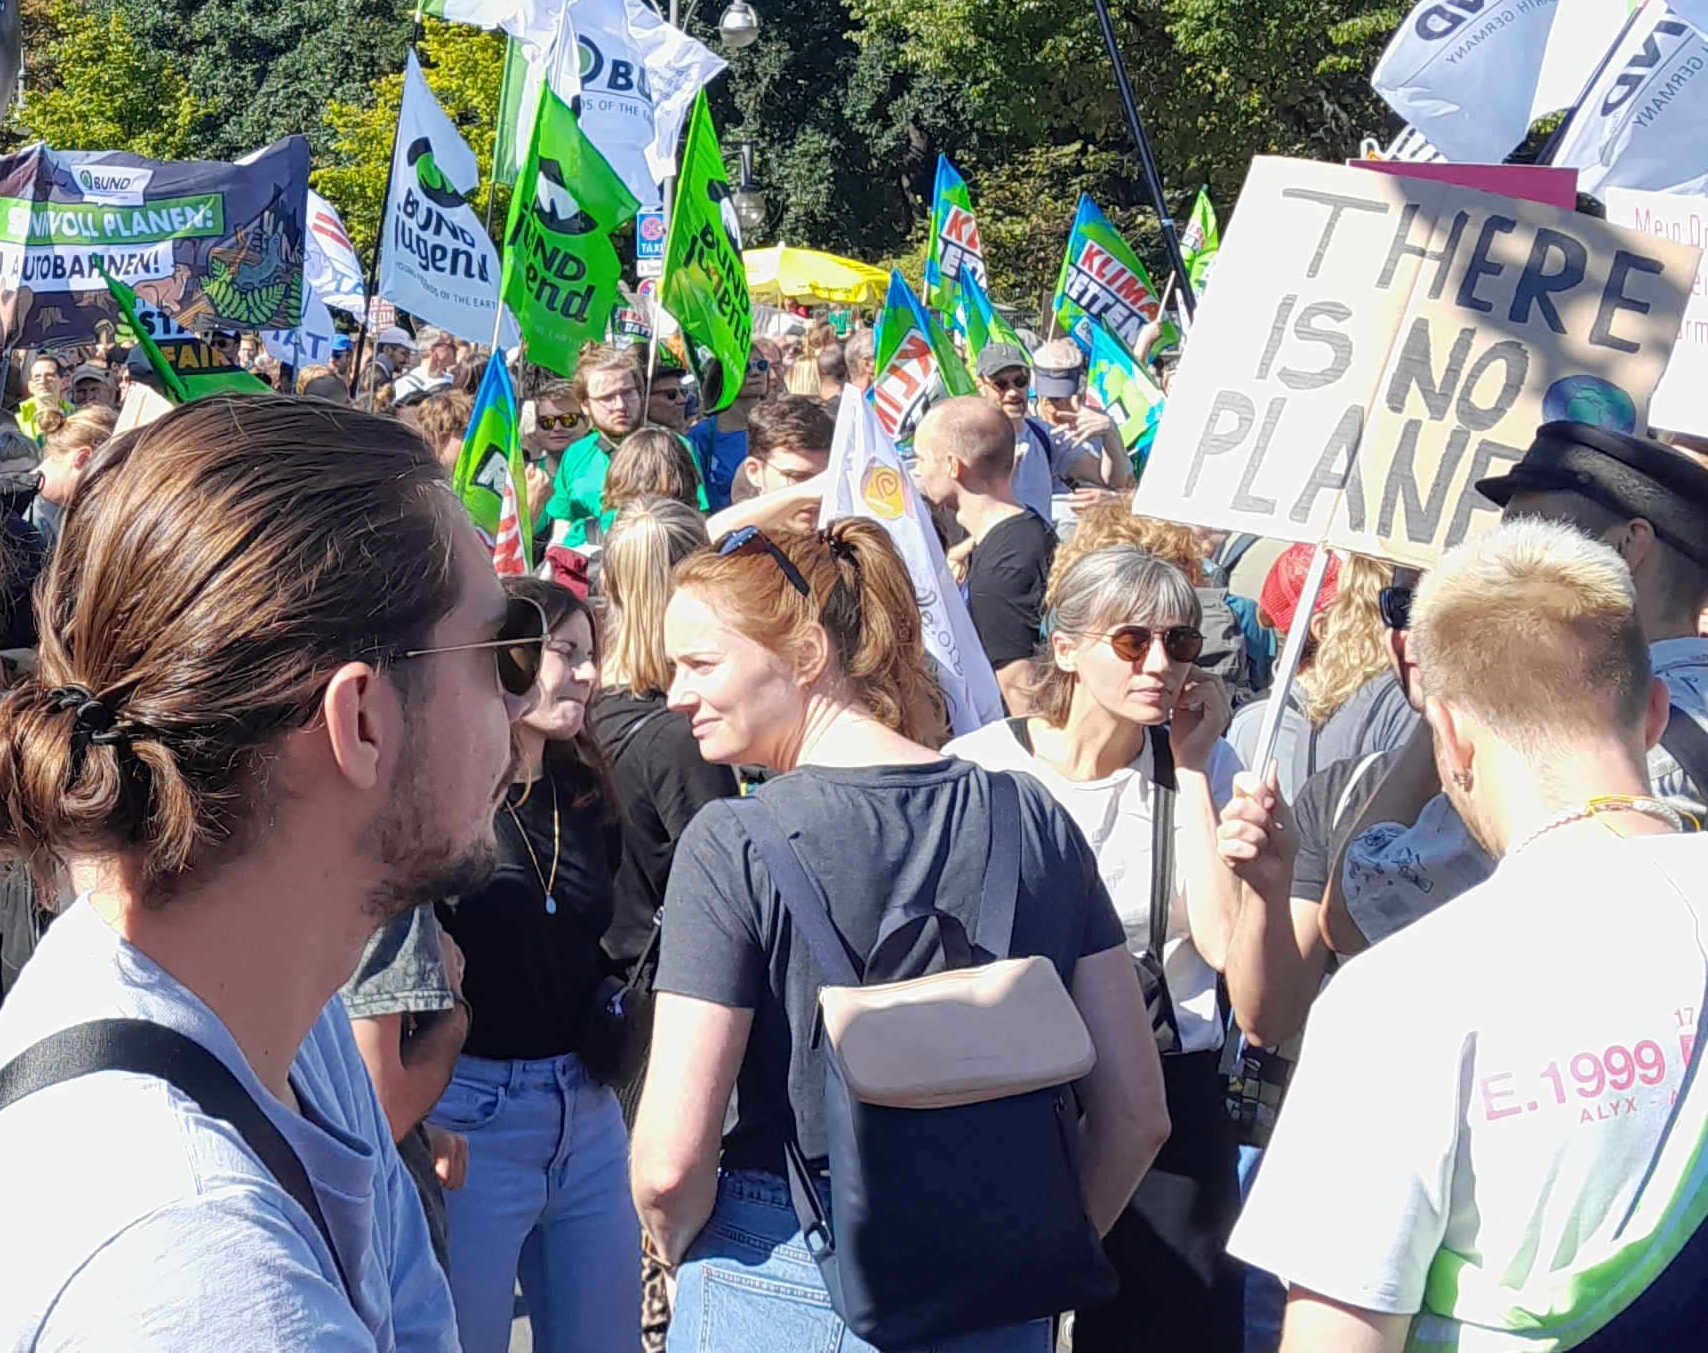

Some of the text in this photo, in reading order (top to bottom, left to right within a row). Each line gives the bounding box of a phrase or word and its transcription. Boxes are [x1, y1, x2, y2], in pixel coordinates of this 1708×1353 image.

[94, 176, 131, 190] BUND
[403, 187, 476, 249] BUND
[104, 203, 215, 238] PLANEN:
[11, 249, 161, 282] AUTOBAHNEN!
[1080, 243, 1161, 321] KLIMA
[1281, 188, 1665, 353] THERE
[1255, 293, 1531, 432] IS NO
[1181, 389, 1526, 549] PLANE
[1480, 1039, 1666, 1121] E.1999
[1579, 1097, 1638, 1124] ALYX
